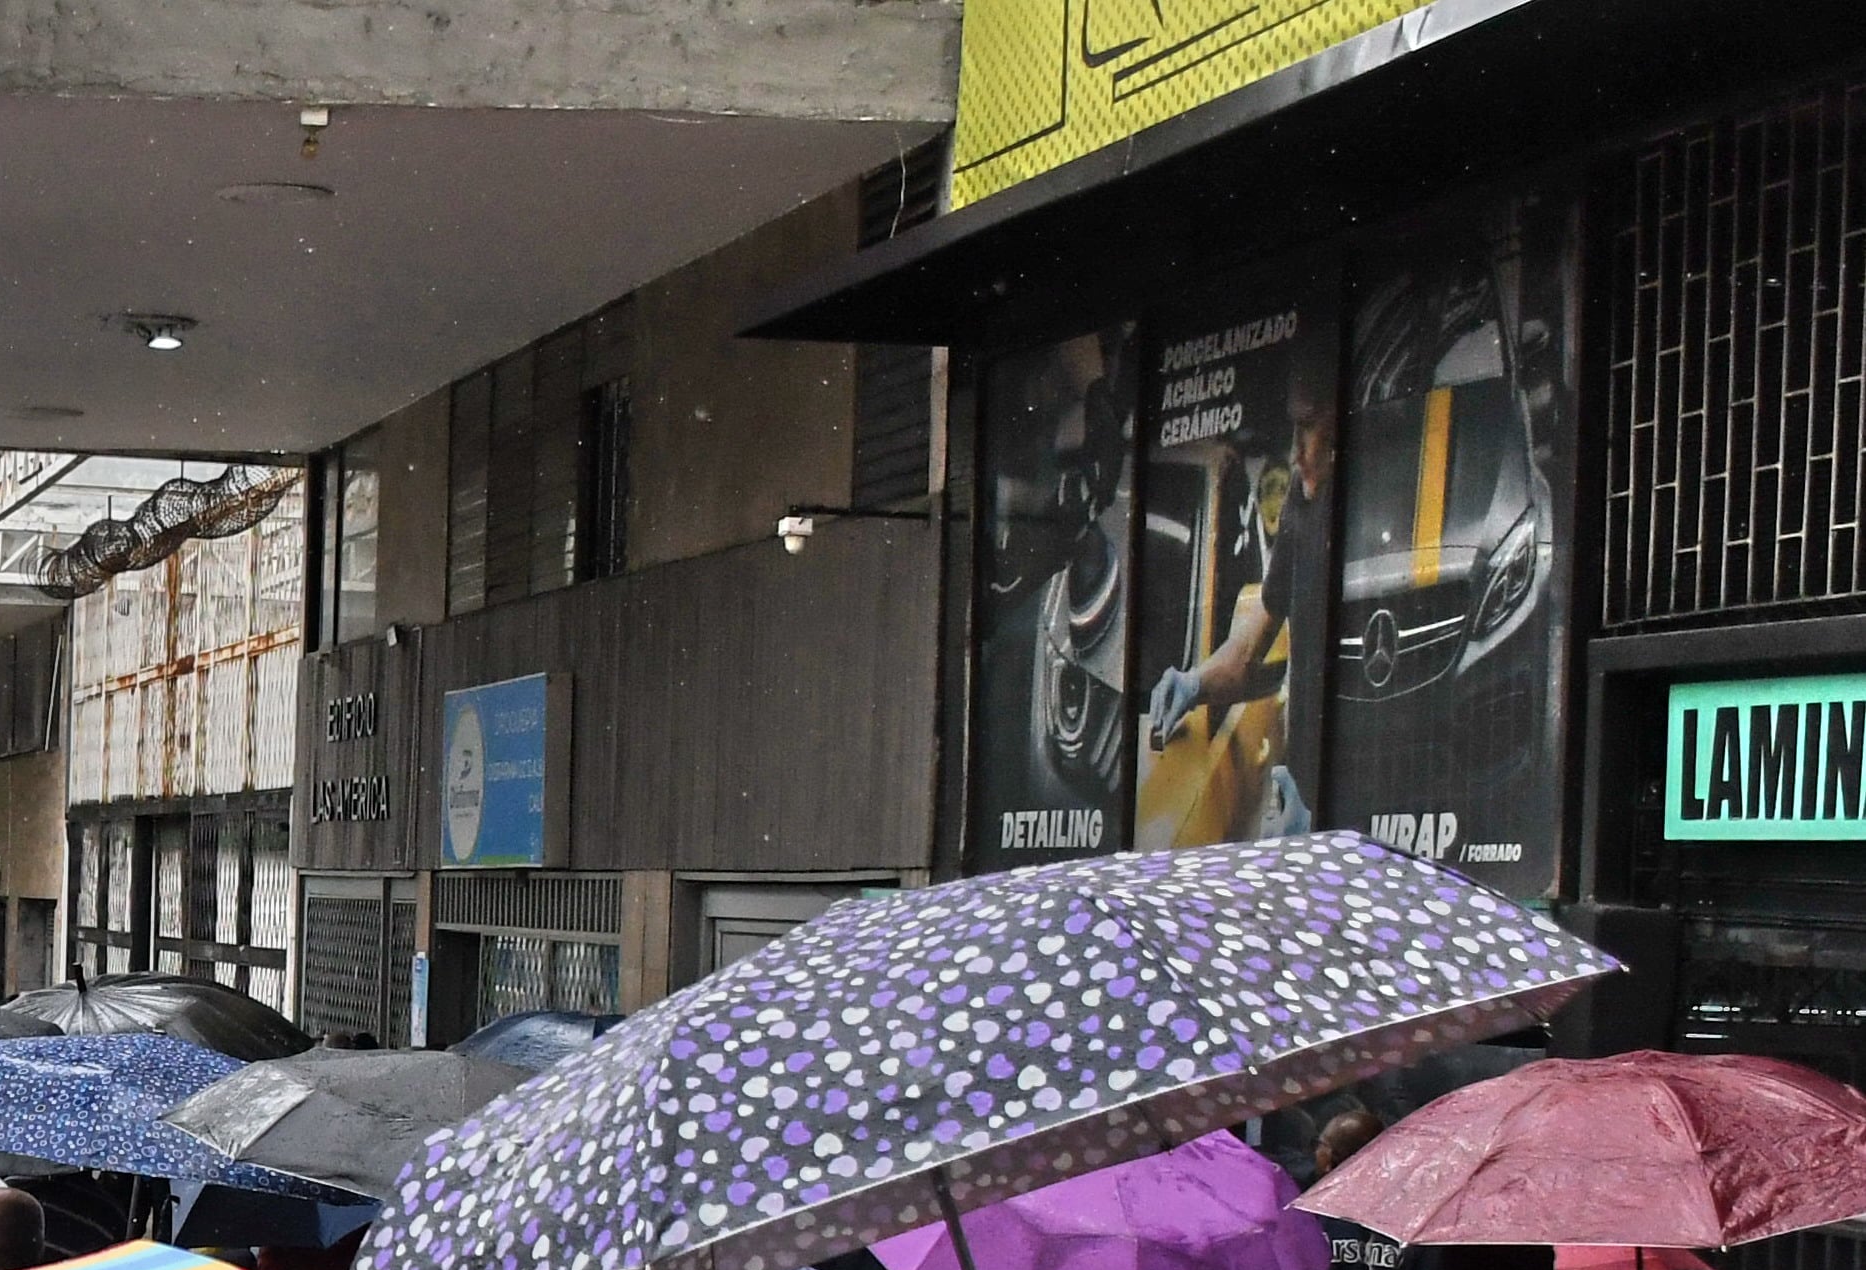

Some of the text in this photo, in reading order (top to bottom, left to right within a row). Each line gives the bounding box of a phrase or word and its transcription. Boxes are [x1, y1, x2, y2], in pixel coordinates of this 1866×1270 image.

[1161, 311, 1298, 371] PORCELANIZADO
[1160, 402, 1243, 447] CERÁMICO
[327, 692, 376, 743] EDIFICIO
[1681, 700, 1866, 821] LAMIN
[310, 778, 334, 825] LAS
[1001, 809, 1103, 849] DETAILING
[1371, 812, 1458, 859] WRAP
